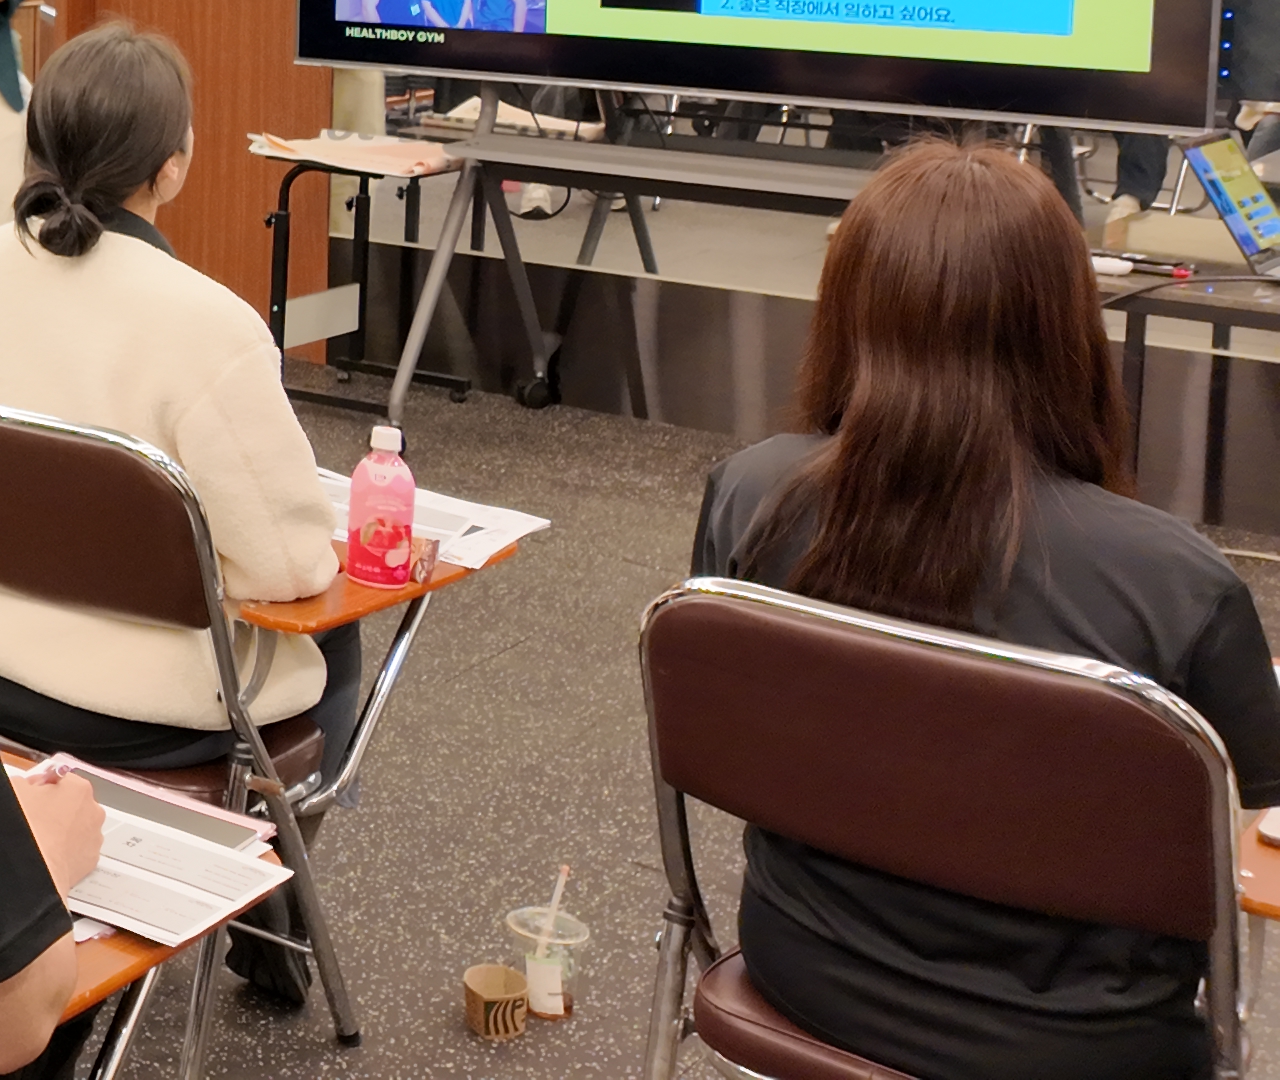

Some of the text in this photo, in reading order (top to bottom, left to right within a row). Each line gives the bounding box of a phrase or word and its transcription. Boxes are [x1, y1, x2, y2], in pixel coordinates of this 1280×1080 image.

[775, 0, 840, 16] 직장에서
[844, 2, 894, 20] 일하고
[345, 26, 445, 43] HEALTHBOY GYM
